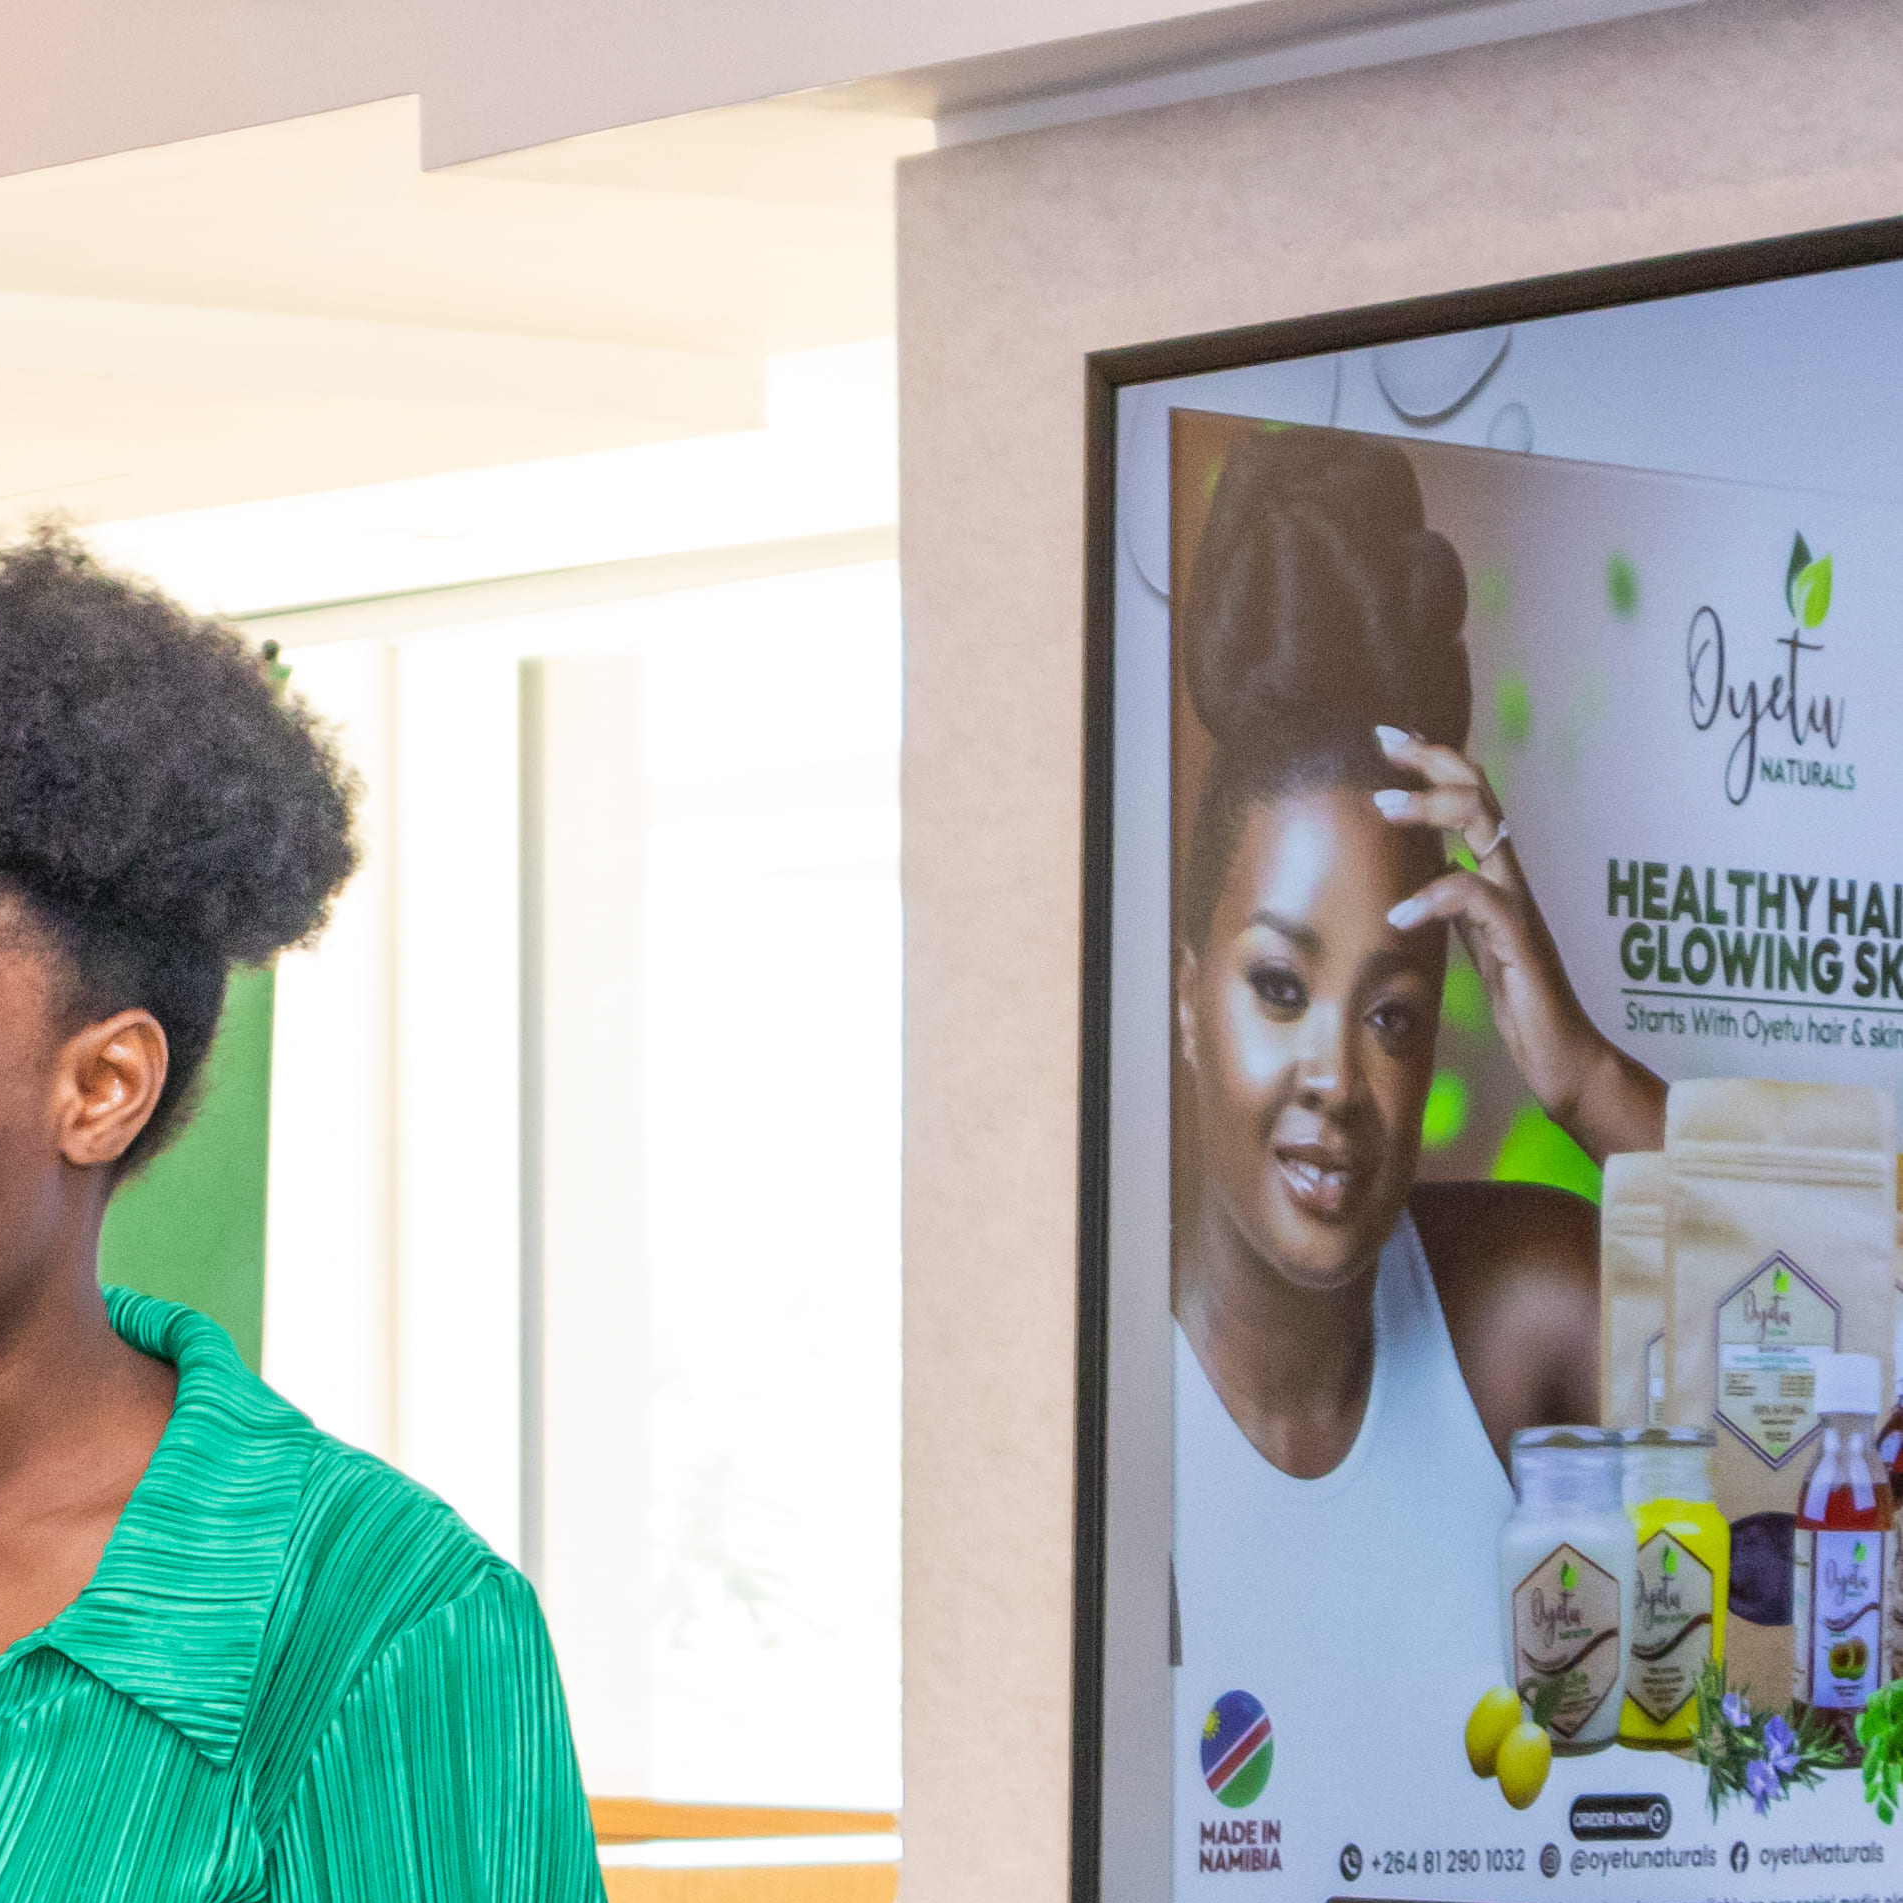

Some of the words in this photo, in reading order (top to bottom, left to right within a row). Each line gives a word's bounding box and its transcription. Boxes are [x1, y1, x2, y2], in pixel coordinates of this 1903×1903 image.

[1687, 604, 1845, 806] Oyetu
[1758, 756, 1856, 791] NATURALS
[1607, 858, 1820, 933] HEALTHY
[1828, 877, 1903, 940] HAI
[1620, 920, 1844, 995] GLOWING
[1625, 1000, 1686, 1035] Starts
[1690, 1006, 1738, 1039] With
[1743, 1009, 1803, 1047] Oyetu
[1807, 1013, 1847, 1044] hair
[1851, 1016, 1865, 1047] &
[1199, 1820, 1258, 1846] MADE
[1261, 1819, 1283, 1845] IN
[1199, 1847, 1283, 1873] NAMIBIA
[1371, 1850, 1418, 1875] +264
[1423, 1850, 1442, 1874] 81
[1447, 1849, 1481, 1873] 290
[1486, 1848, 1527, 1873] 1032
